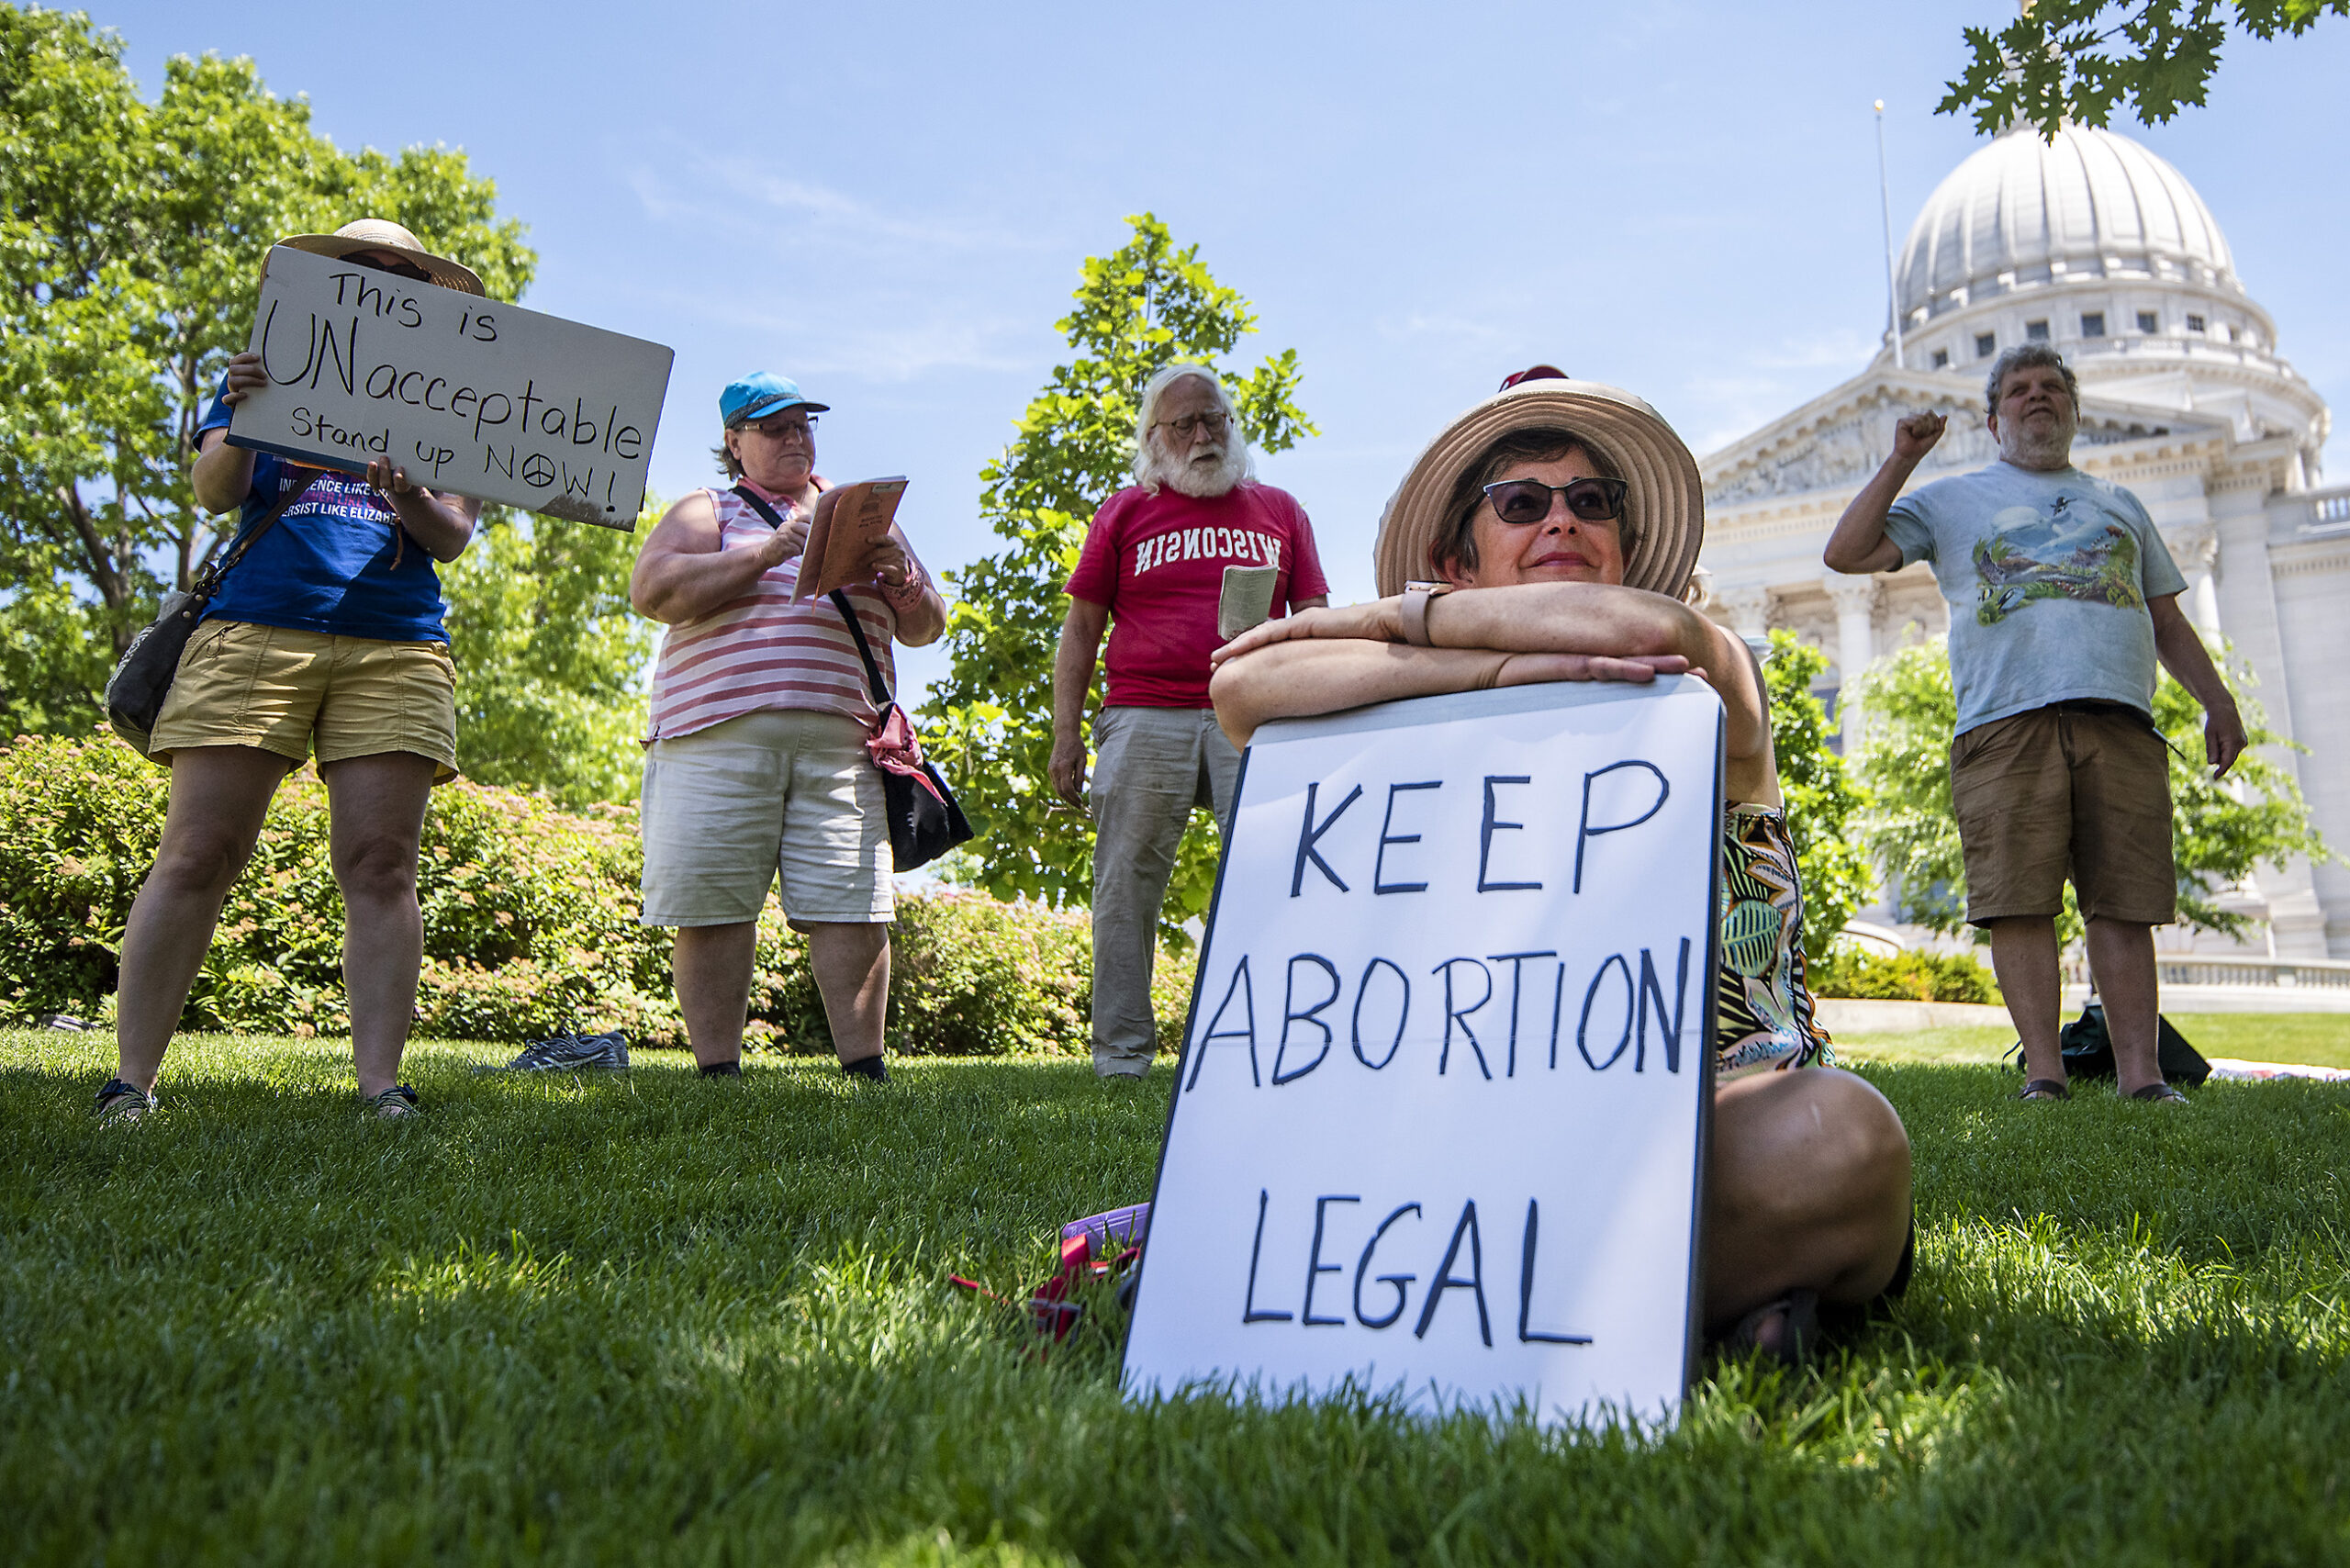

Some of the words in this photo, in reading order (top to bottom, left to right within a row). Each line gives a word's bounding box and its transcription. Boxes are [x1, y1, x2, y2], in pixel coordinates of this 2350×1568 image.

[330, 273, 422, 328] This
[460, 305, 498, 342] is
[263, 299, 643, 459] UNacceptable
[291, 407, 389, 454] Stand
[416, 441, 454, 479] up
[344, 483, 372, 497] LIKE
[281, 501, 319, 518] ERSIST
[320, 503, 348, 518] LIKE
[350, 507, 397, 526] ELIZABE
[1291, 759, 1670, 897] KEEP
[1185, 937, 1691, 1092] ABORTION
[1242, 1189, 1594, 1348] LEGAL
